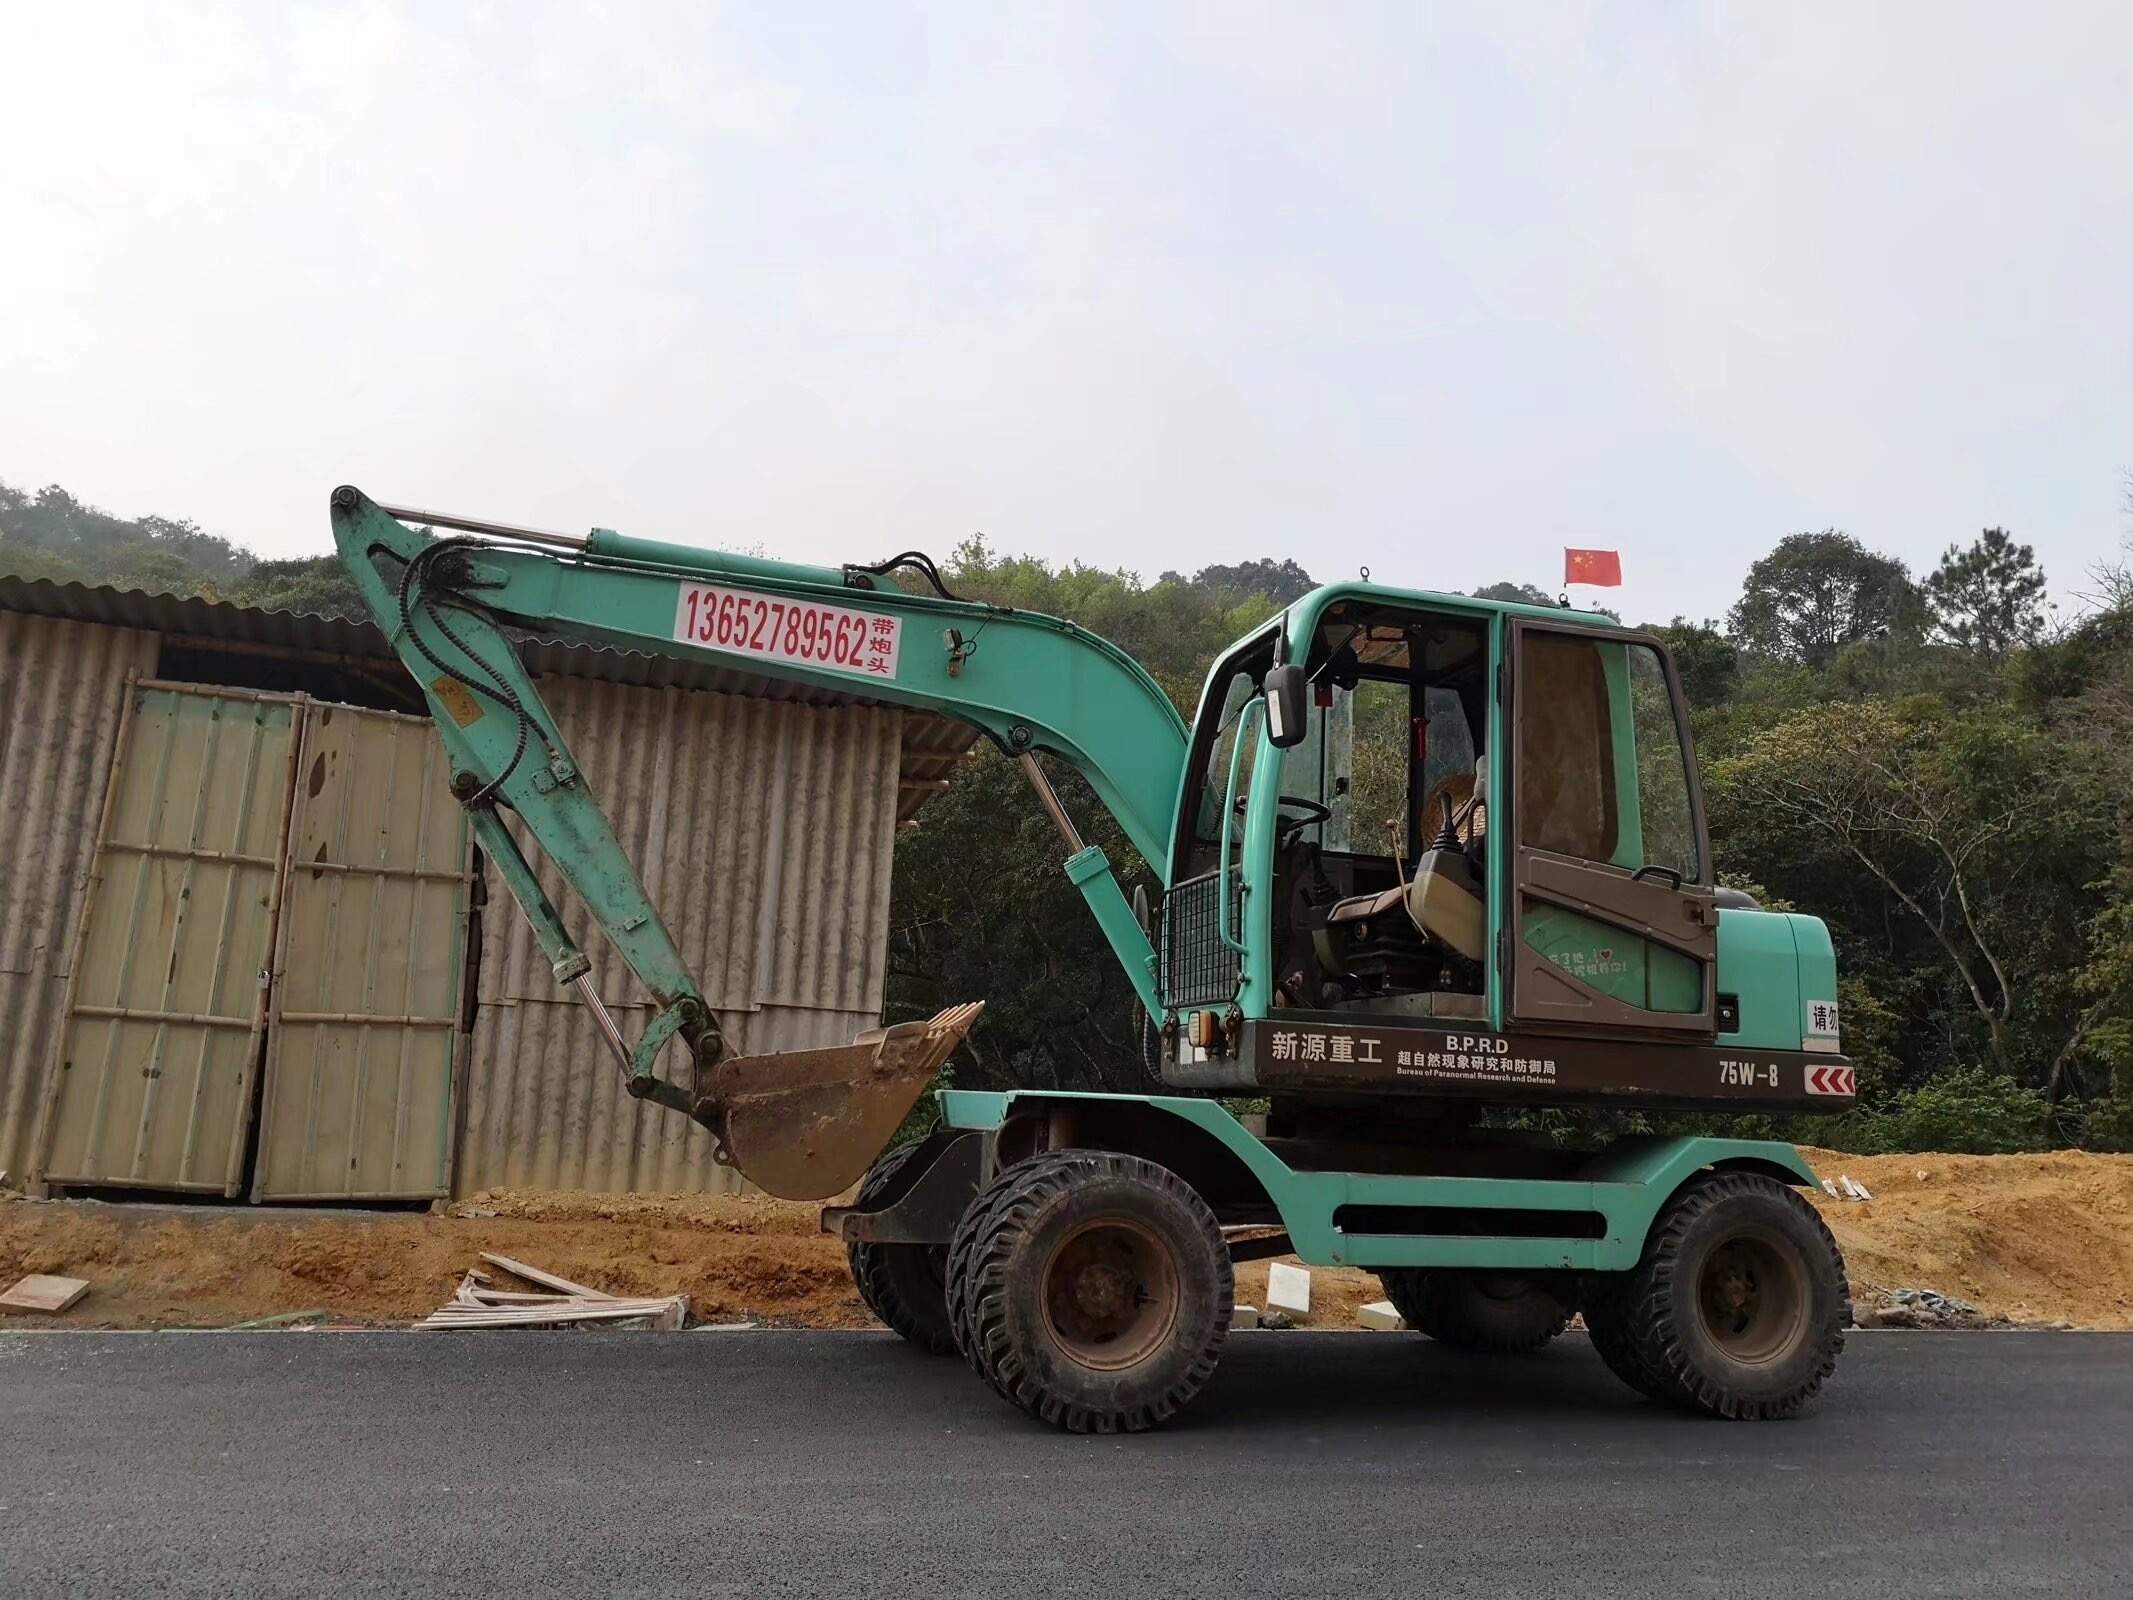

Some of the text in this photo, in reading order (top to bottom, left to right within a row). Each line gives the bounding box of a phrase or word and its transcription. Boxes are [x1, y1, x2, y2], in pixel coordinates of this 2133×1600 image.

[687, 590, 868, 667] 13652789562
[867, 617, 895, 674] 带炮头
[1814, 1005, 1837, 1031] 请勿
[1272, 1031, 1383, 1064] 新源重工
[1446, 1035, 1509, 1054] B.P.R.D
[1397, 1050, 1556, 1076] 超自然现象研究和防御局
[1397, 1066, 1424, 1077] Bureau
[1434, 1069, 1477, 1080] Paranormal
[1477, 1072, 1511, 1082] Research
[1511, 1074, 1526, 1083] and
[1720, 1061, 1778, 1087] 75W-8
